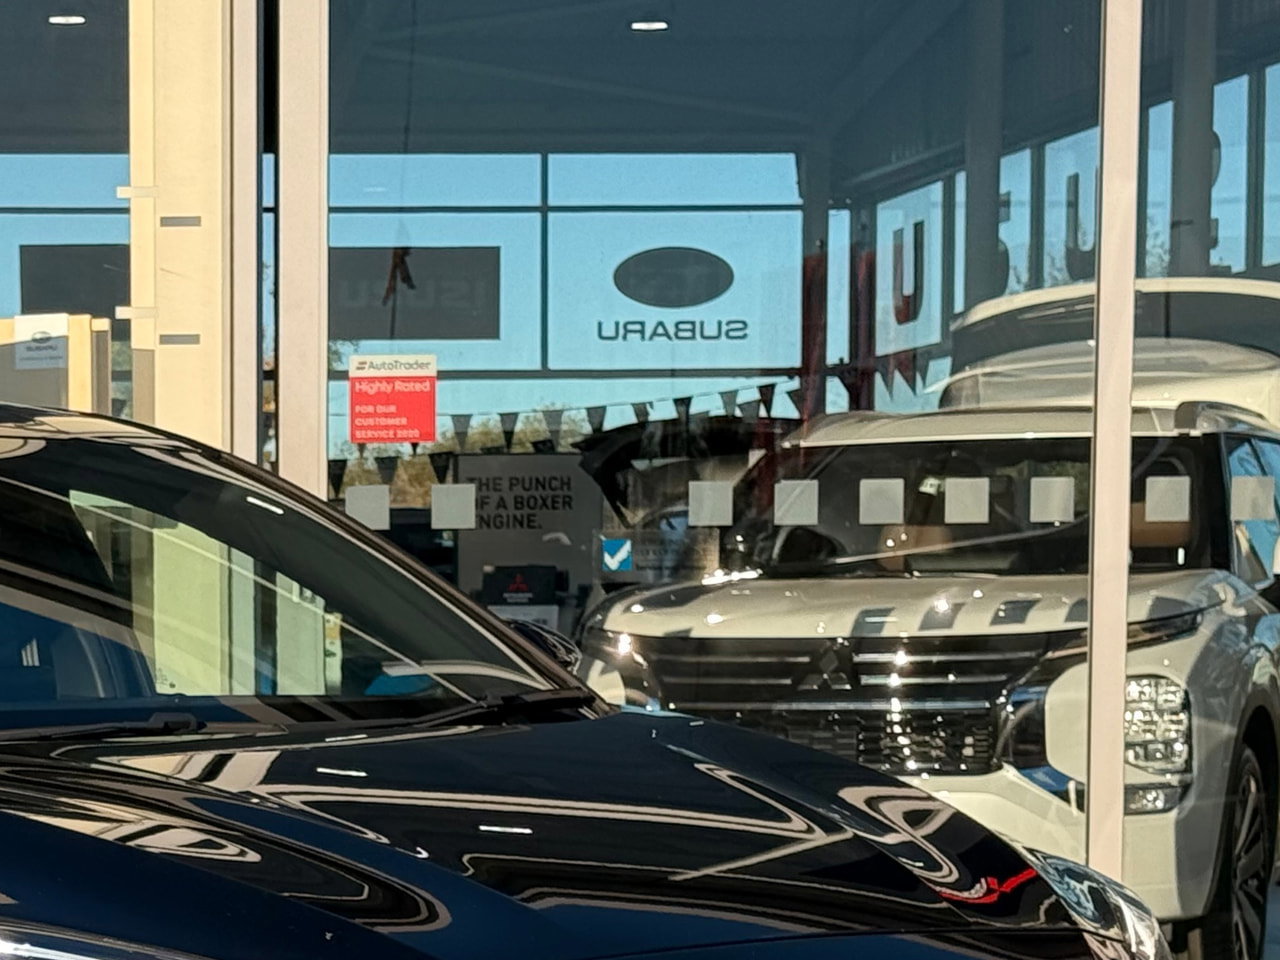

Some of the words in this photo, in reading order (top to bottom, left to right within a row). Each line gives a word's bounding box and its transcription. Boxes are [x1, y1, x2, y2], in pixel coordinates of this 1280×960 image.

[368, 360, 431, 371] AutoTrader
[355, 380, 394, 395] Highly
[394, 380, 431, 392] Rated
[507, 475, 572, 492] PUNCH
[494, 495, 509, 511] A
[513, 494, 574, 511] BOXER
[476, 513, 543, 530] NGINE.
